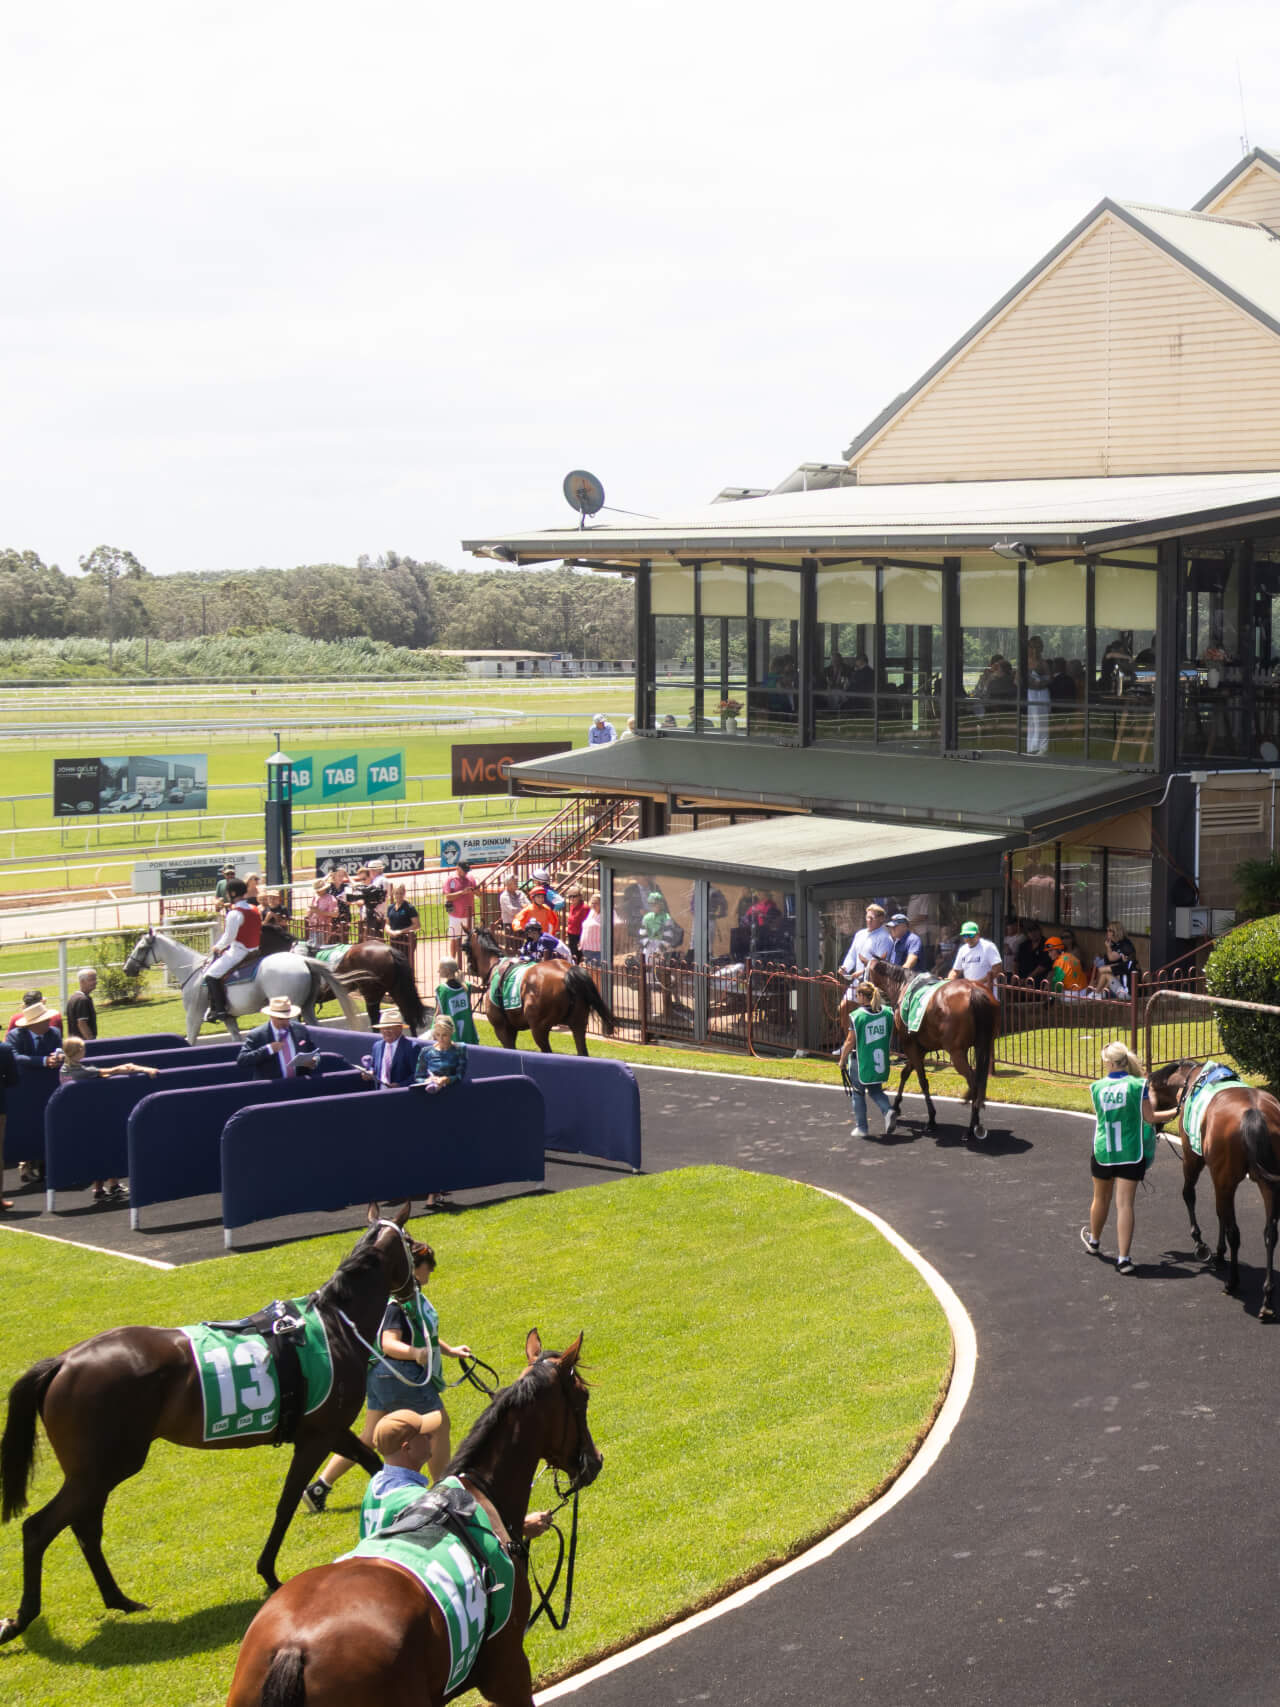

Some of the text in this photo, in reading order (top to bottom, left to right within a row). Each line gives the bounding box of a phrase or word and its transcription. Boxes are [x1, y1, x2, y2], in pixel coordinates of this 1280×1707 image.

[325, 768, 355, 784] TAB
[369, 766, 399, 782] TAB
[463, 837, 511, 847] FAIR DINKUM
[391, 857, 422, 871] DRY
[450, 999, 467, 1008] TAB
[867, 1025, 885, 1035] TAB
[873, 1048, 886, 1074] 9
[1103, 1091, 1124, 1104] TAB
[1105, 1120, 1123, 1152] 11
[203, 1340, 276, 1417] 13
[426, 1542, 487, 1653] 14
